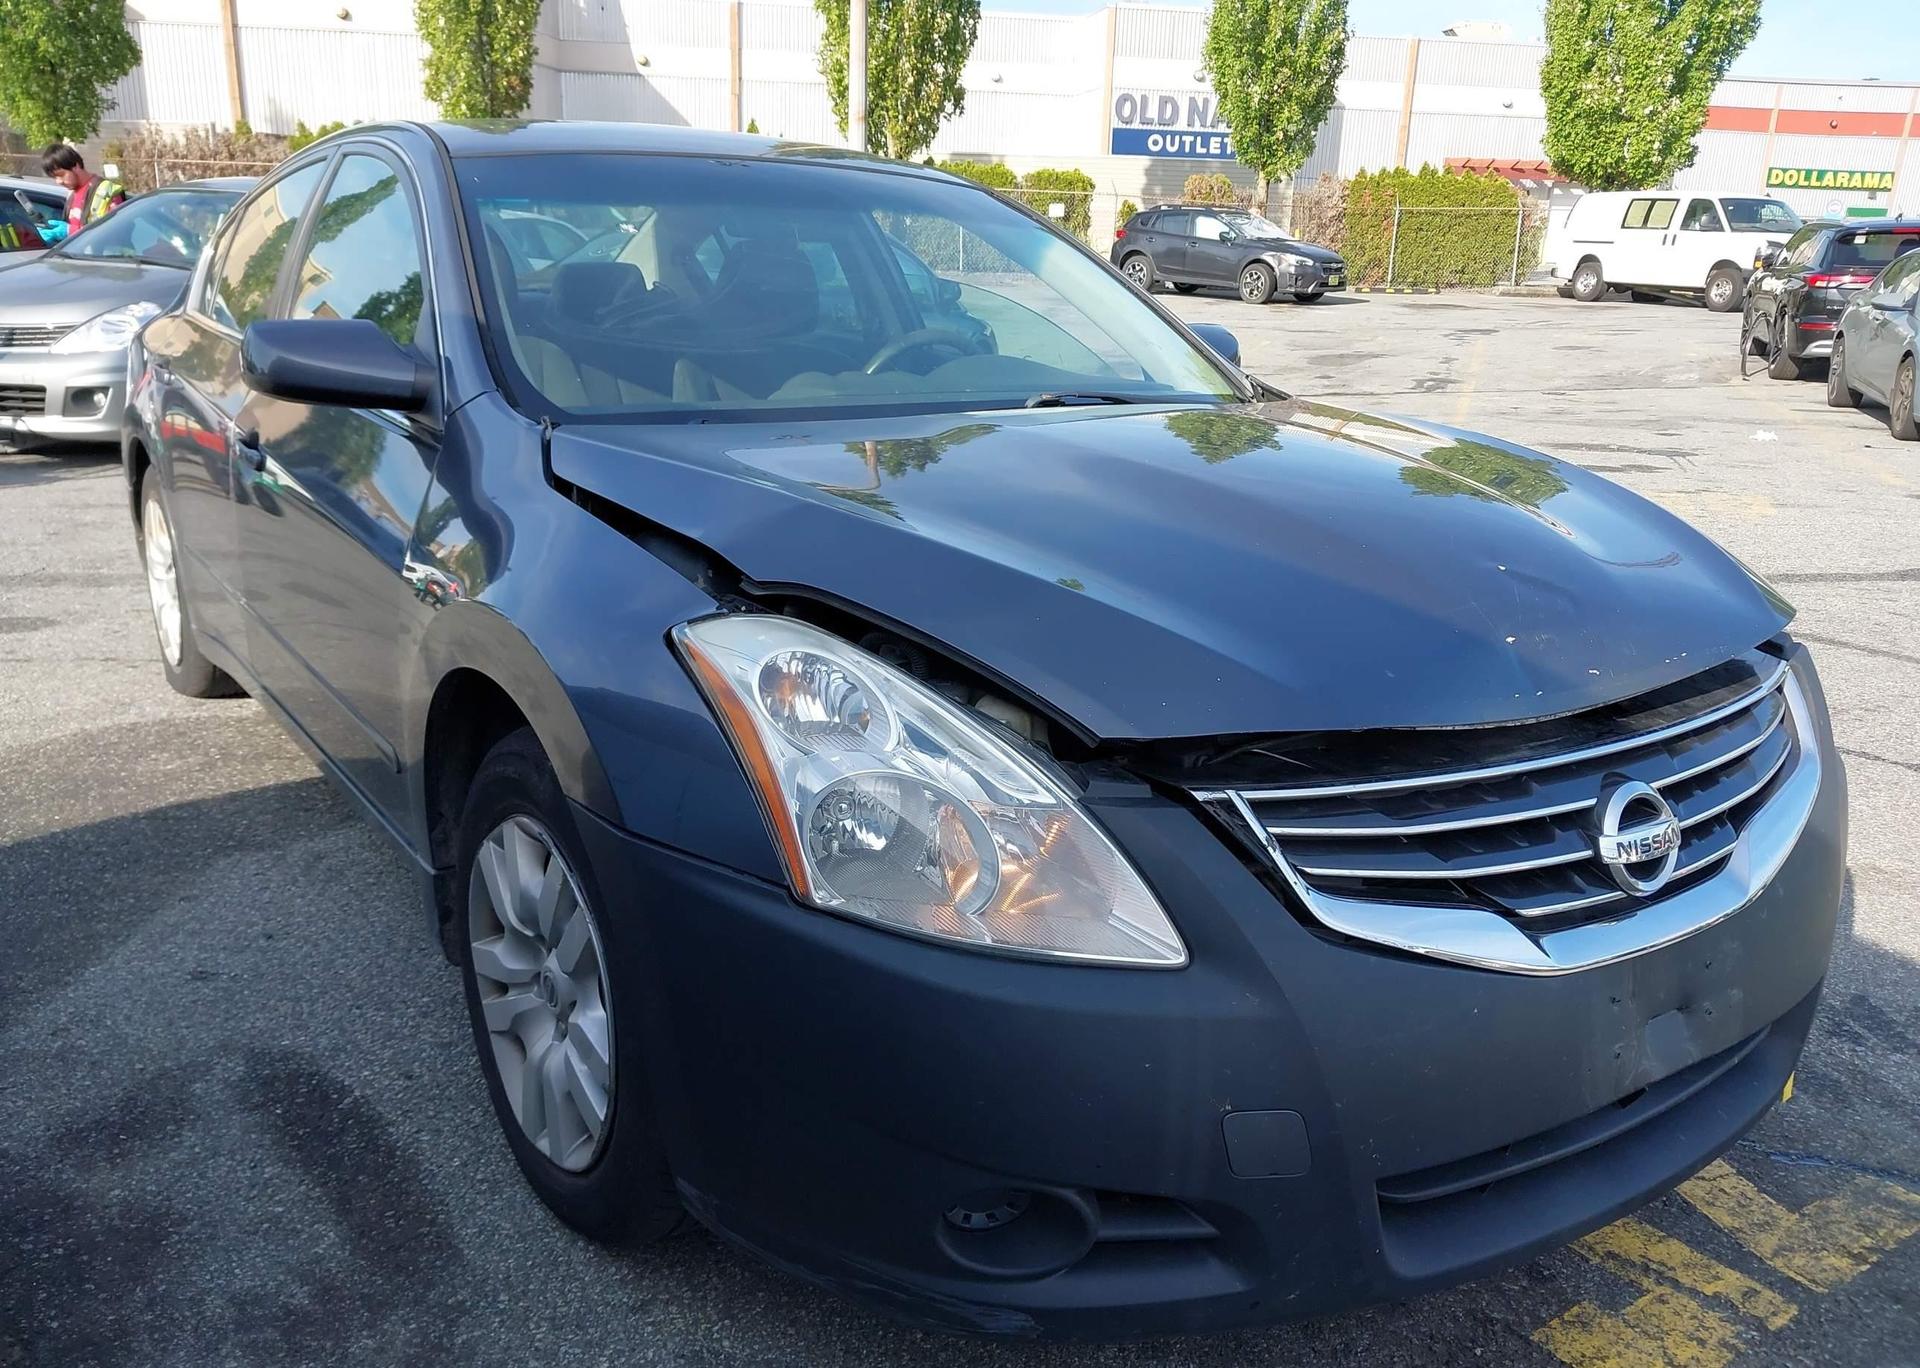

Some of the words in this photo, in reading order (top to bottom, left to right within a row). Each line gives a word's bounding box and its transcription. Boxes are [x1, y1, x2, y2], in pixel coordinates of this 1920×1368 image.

[1115, 93, 1179, 126] OLD
[1187, 96, 1232, 128] NA
[1147, 133, 1233, 155] OUTLET
[1768, 168, 1893, 189] DOLLARAMA
[1616, 825, 1680, 858] NISSAN
